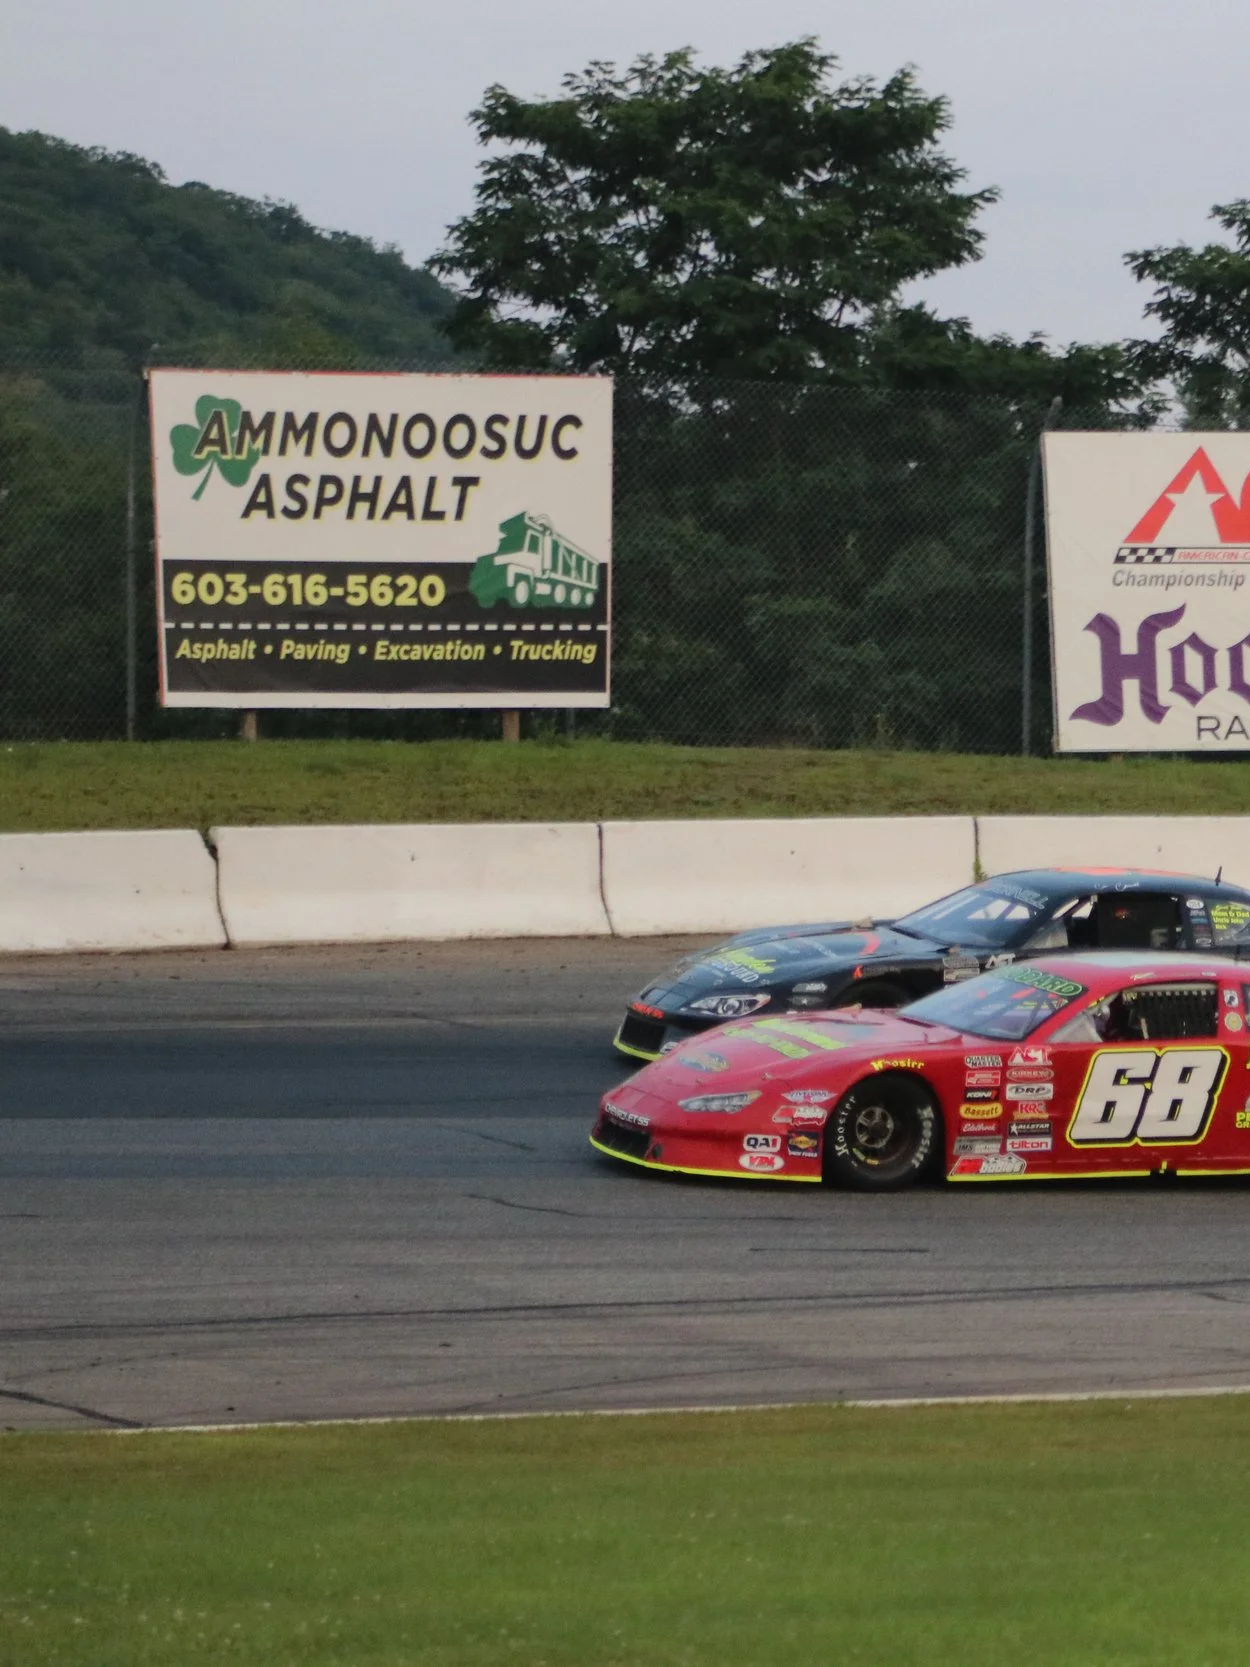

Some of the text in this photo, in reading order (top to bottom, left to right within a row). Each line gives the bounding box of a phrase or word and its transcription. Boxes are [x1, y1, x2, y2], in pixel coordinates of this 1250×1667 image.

[193, 410, 584, 461] AMMONOOSUC
[241, 473, 481, 522] ASPHALT
[1177, 551, 1239, 561] AMERICAN
[171, 572, 446, 608] 603-616-5620
[1112, 568, 1246, 591] Championship
[176, 639, 597, 664] Asphalt Paving Excavation Trucking
[1008, 1046, 1053, 1064] ACT
[1067, 1047, 1230, 1147] 68
[835, 1095, 857, 1157] Hoosier
[746, 1137, 778, 1149] QA1
[1009, 1141, 1049, 1149] tilton
